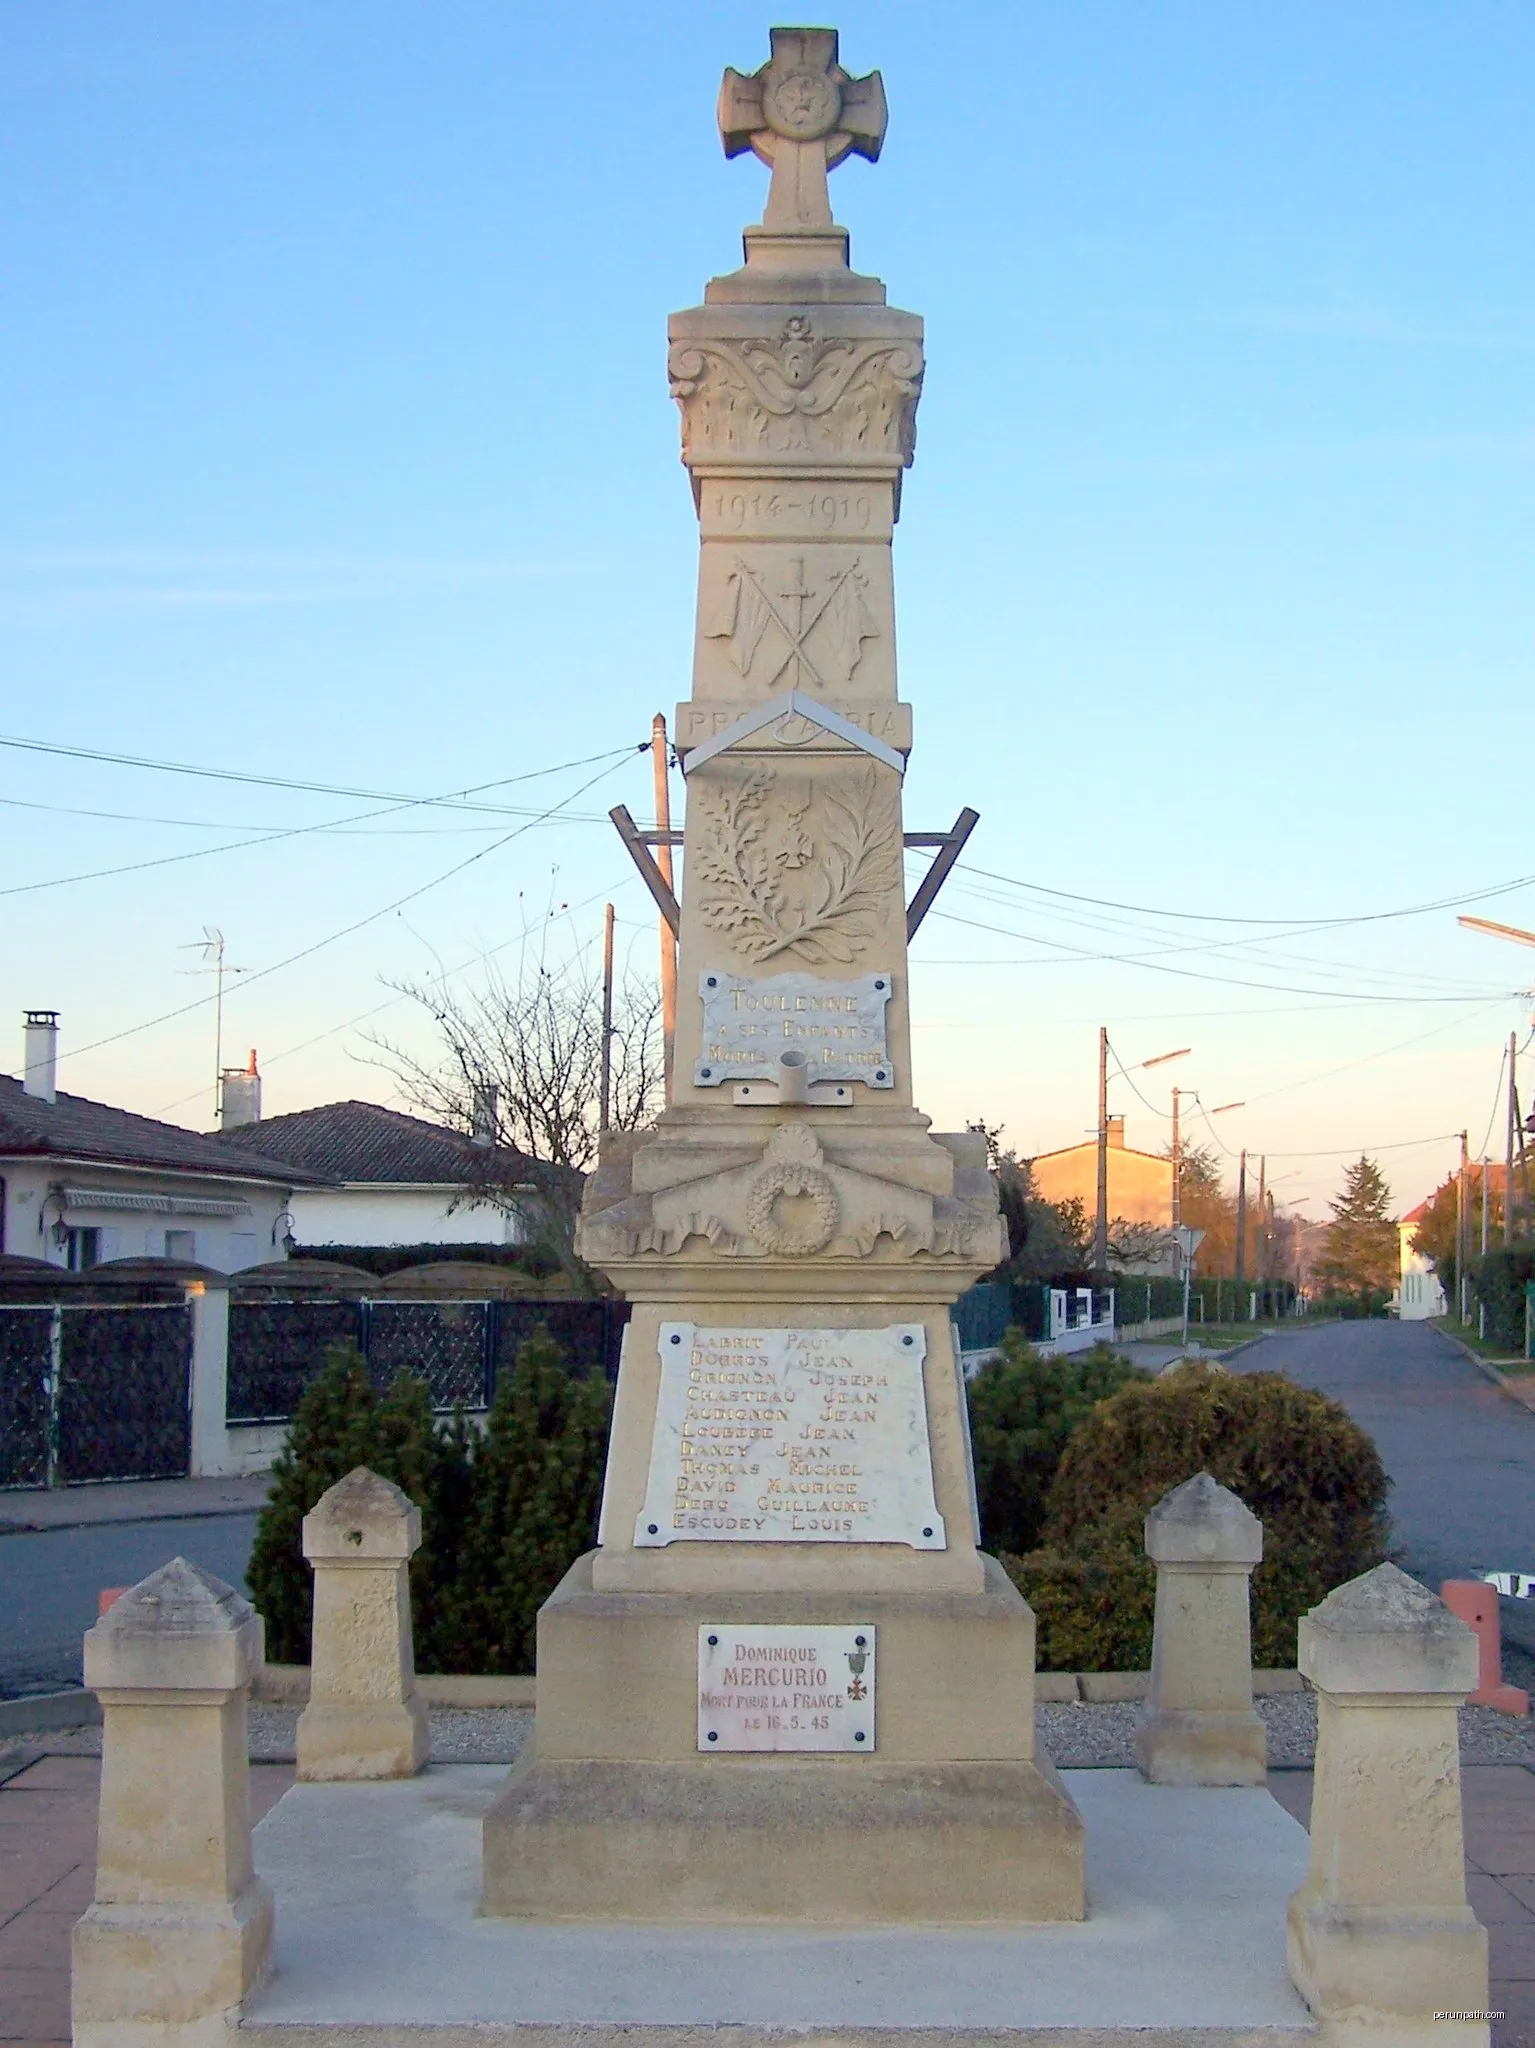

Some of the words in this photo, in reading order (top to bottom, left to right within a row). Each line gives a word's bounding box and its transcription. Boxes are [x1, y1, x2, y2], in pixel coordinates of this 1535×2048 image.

[716, 493, 871, 531] 1914-1919
[735, 1643, 817, 1664] DOMINIQUE
[723, 1667, 827, 1687] MERCURIO
[793, 1693, 844, 1709] FRANCE
